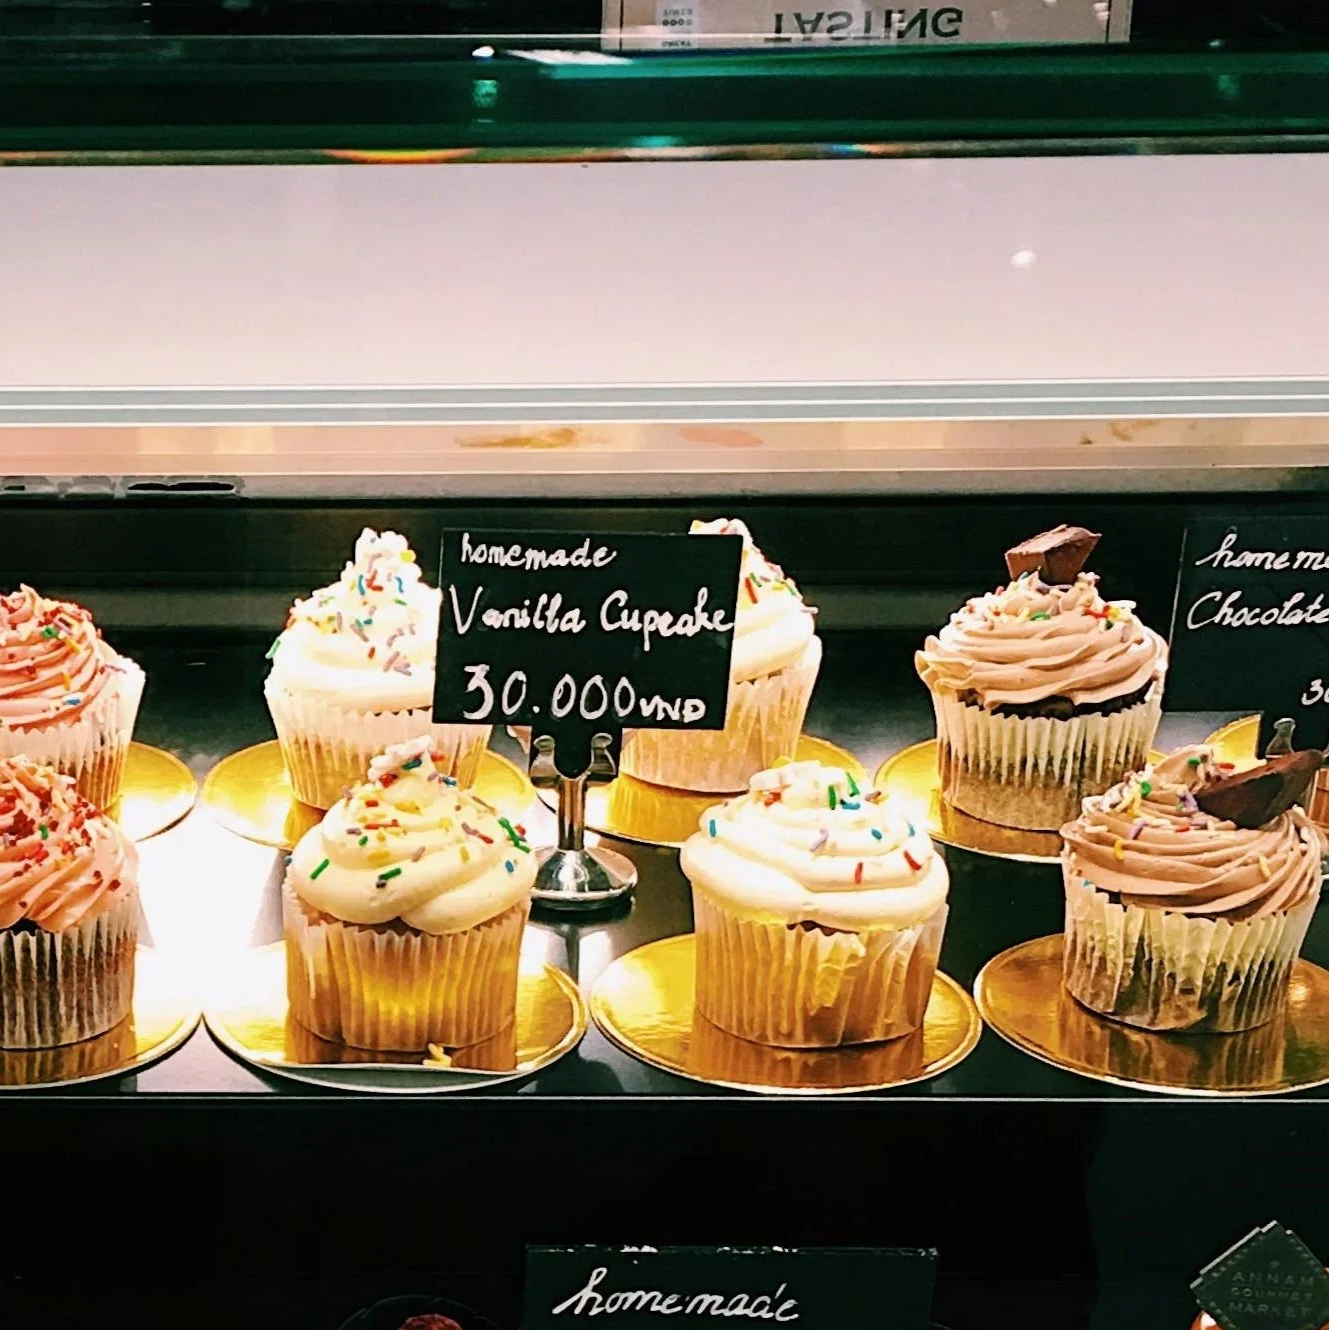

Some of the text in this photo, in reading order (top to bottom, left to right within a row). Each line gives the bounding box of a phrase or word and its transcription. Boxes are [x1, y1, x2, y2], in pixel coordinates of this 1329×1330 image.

[461, 533, 617, 570] homemade
[449, 584, 734, 652] Vanilla Cupcake
